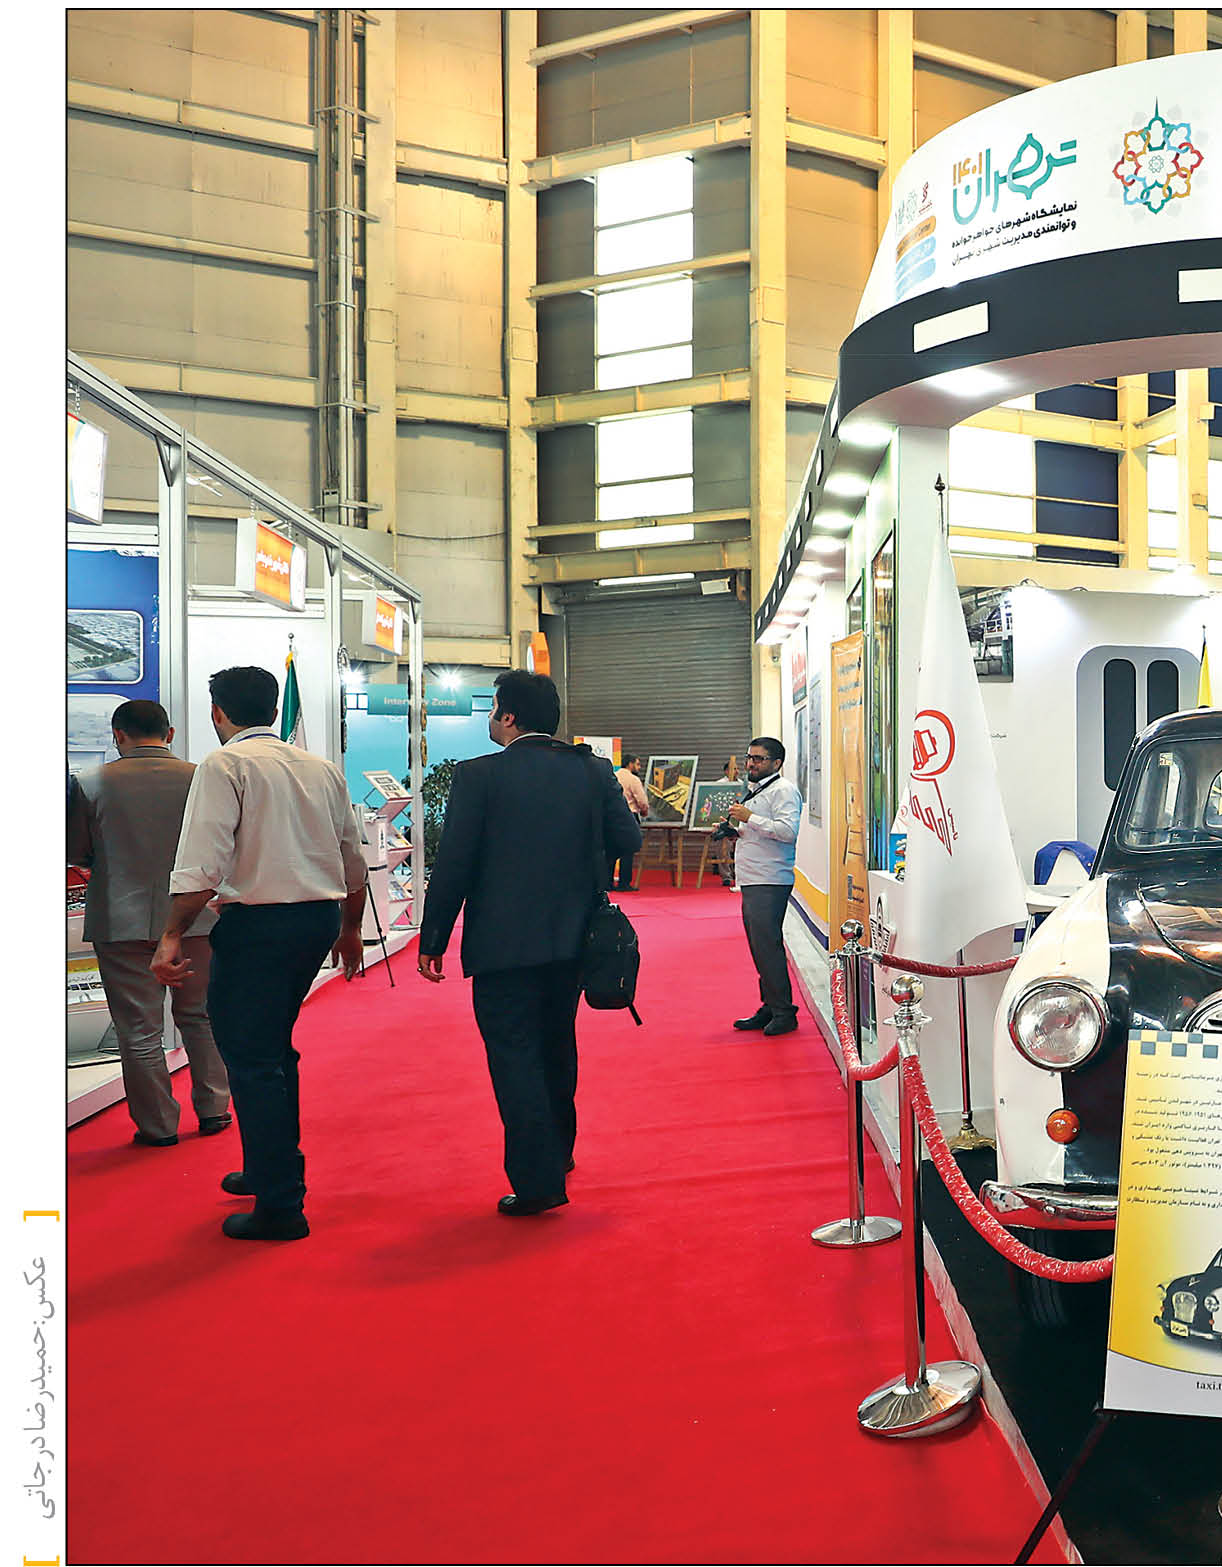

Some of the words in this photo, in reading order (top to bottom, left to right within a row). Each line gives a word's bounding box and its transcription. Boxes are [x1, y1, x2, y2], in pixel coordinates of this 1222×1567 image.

[952, 132, 1078, 226] تهران
[1031, 200, 1078, 221] نمایشگاه
[996, 211, 1031, 234] شهرهای
[1033, 218, 1071, 239] توانمندی
